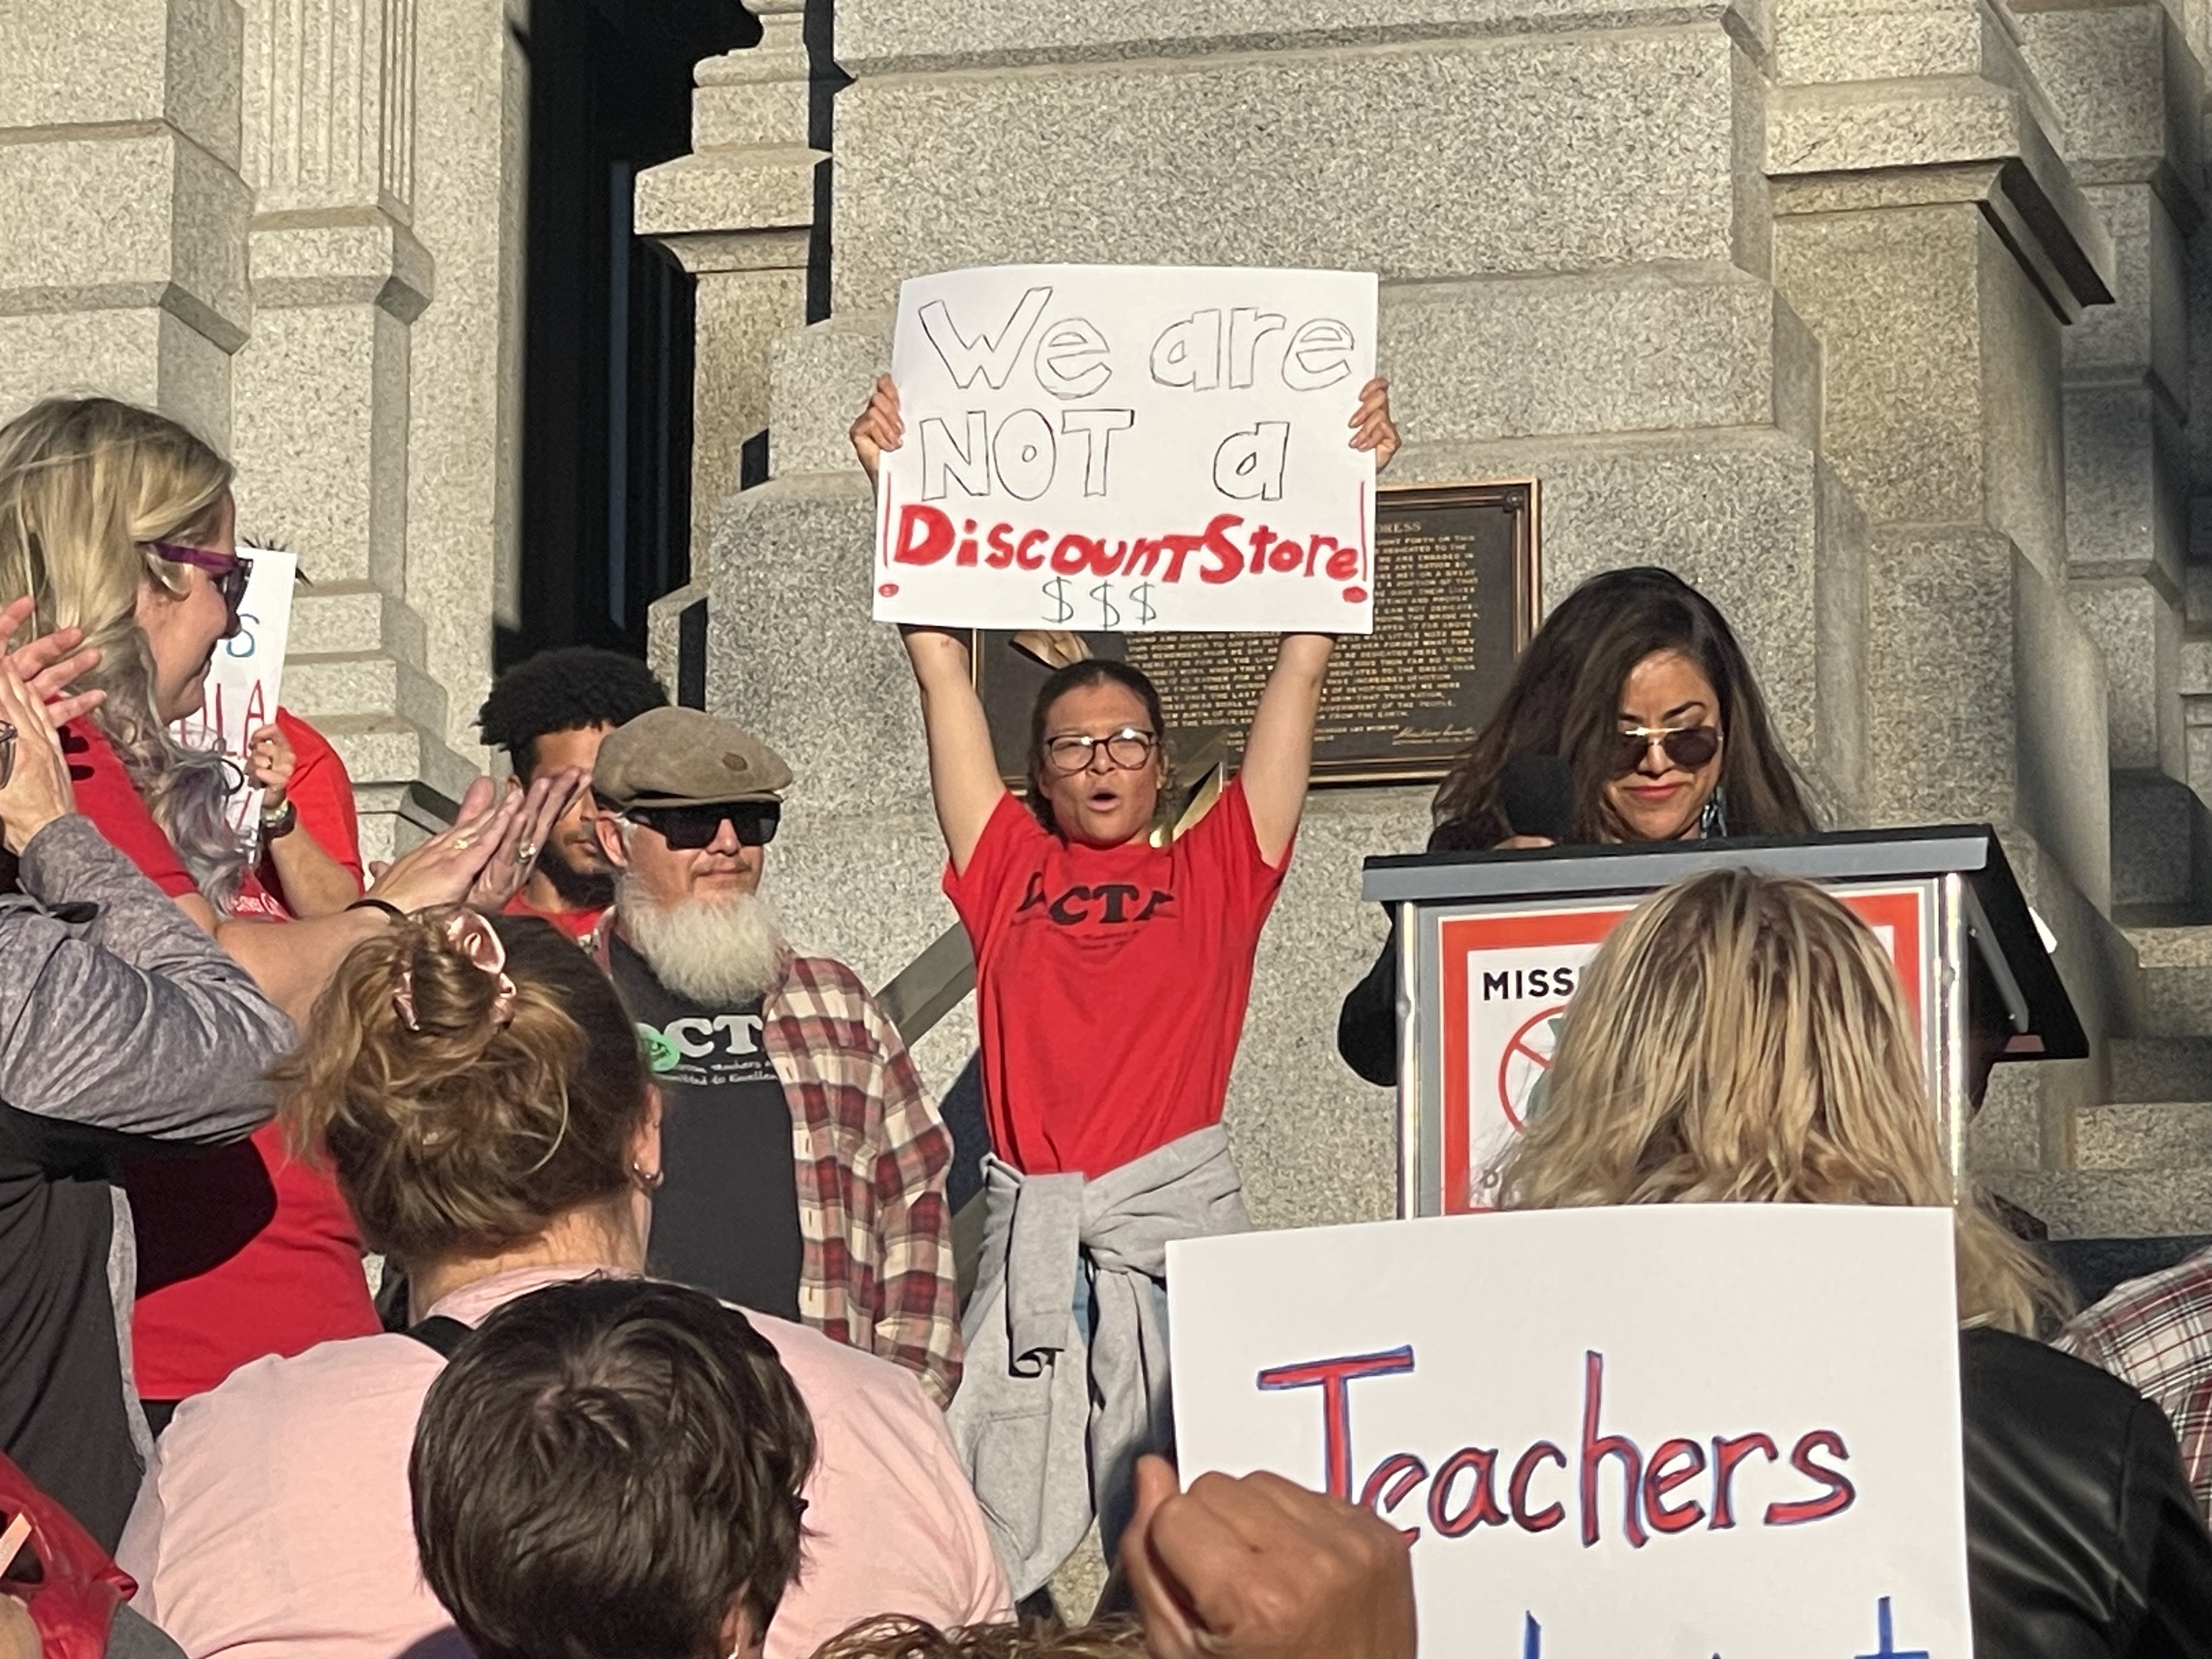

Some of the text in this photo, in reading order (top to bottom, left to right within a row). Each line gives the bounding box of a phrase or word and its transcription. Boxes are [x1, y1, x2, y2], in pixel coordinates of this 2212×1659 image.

[919, 286, 1355, 400] We are
[921, 409, 1290, 502] NOT a
[1256, 1345, 1857, 1550] Teachers
